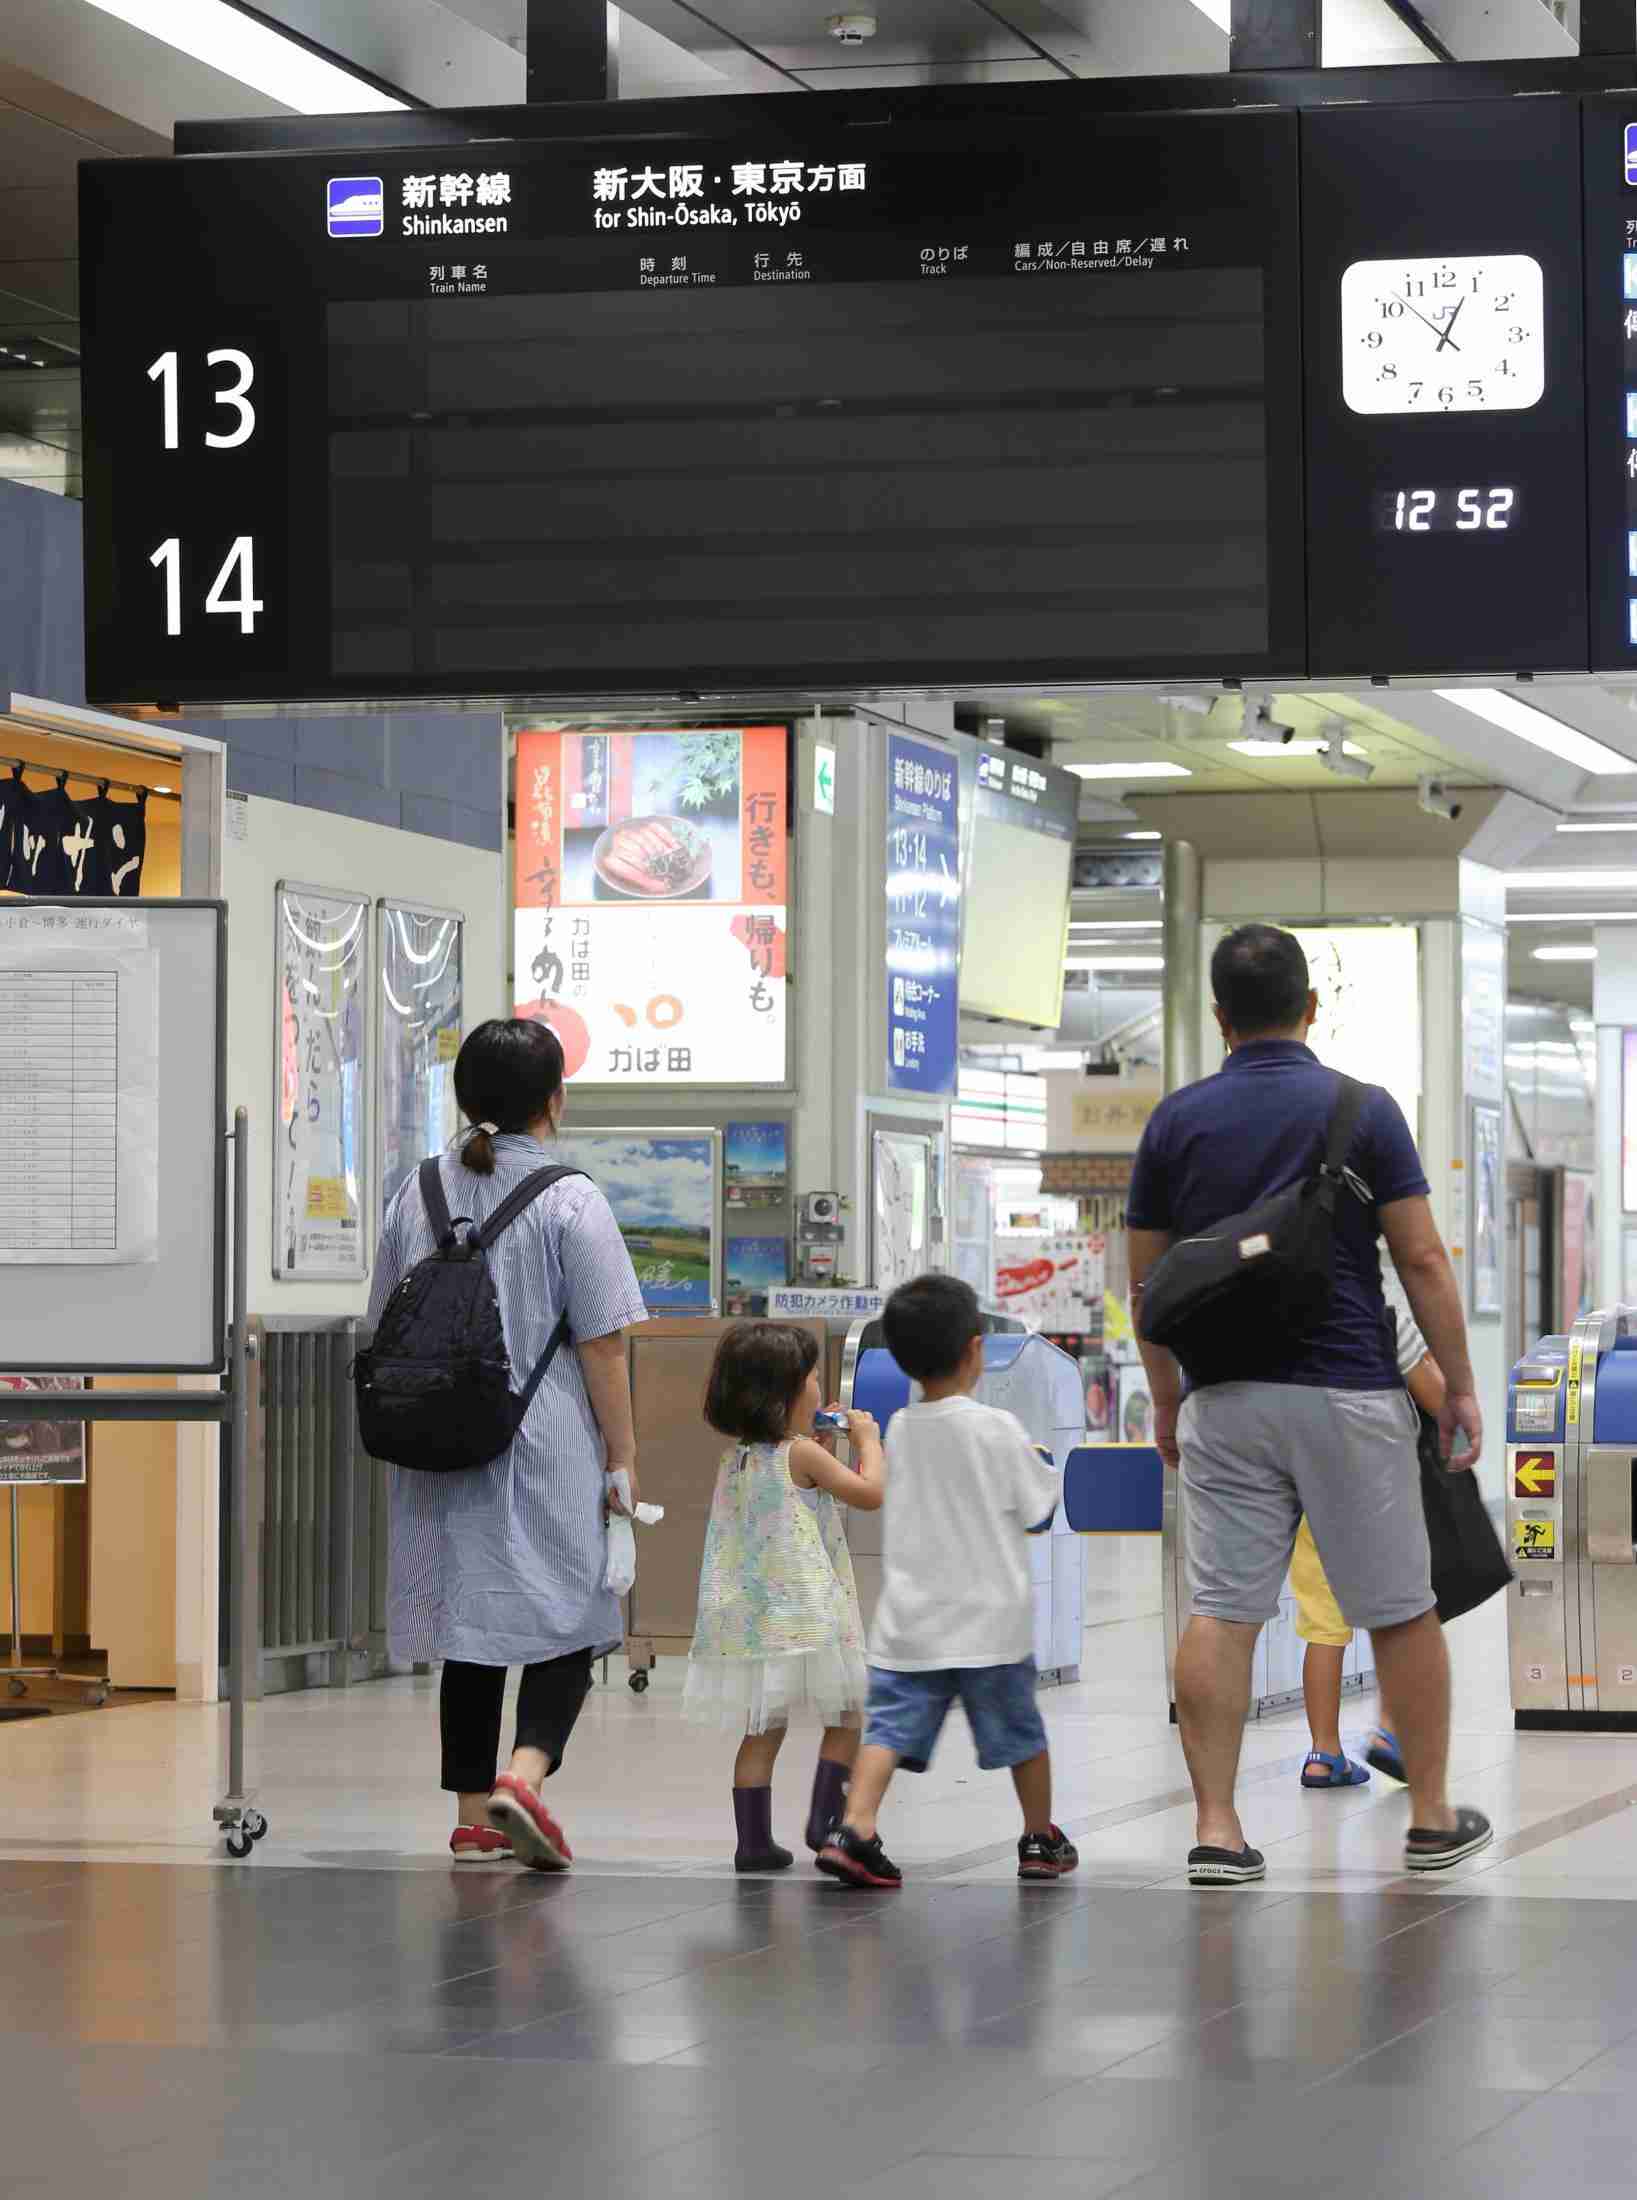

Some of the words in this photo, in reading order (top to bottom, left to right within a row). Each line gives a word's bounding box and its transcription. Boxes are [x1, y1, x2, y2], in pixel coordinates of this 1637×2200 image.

[592, 160, 867, 202] 新大阪・東京方面
[402, 172, 512, 208] 新幹線
[402, 212, 508, 236] Shinkansen
[594, 207, 622, 229] for
[627, 203, 738, 228] Shin-Ōsaka,
[744, 202, 801, 226] Tōkyō
[755, 251, 803, 269] 行先
[920, 245, 969, 261] のりば
[430, 264, 488, 281] 列車名
[640, 256, 687, 273] 時刻
[921, 263, 947, 275] Track
[640, 274, 689, 289] Departure
[692, 273, 716, 284] Time
[754, 268, 811, 281] Destination
[1432, 271, 1457, 288] 12
[430, 283, 455, 294] Train
[458, 282, 487, 293] Name
[1406, 280, 1424, 297] 11
[1471, 276, 1479, 293] 1
[1381, 301, 1404, 319] 10
[1494, 295, 1510, 312] 2
[1367, 331, 1383, 349] 9
[1508, 326, 1524, 344] 3
[1381, 362, 1397, 380] 8
[1494, 358, 1511, 375] 4
[1408, 381, 1423, 398] 7
[1437, 386, 1454, 403] 6
[1468, 379, 1483, 397] 5
[147, 348, 256, 449] 13
[1394, 490, 1436, 531] 12
[1455, 488, 1514, 530] 52
[149, 535, 264, 636] 14
[895, 758, 952, 801] 新幹線のりば
[1530, 1667, 1541, 1680] 3
[1622, 1668, 1633, 1681] 2
